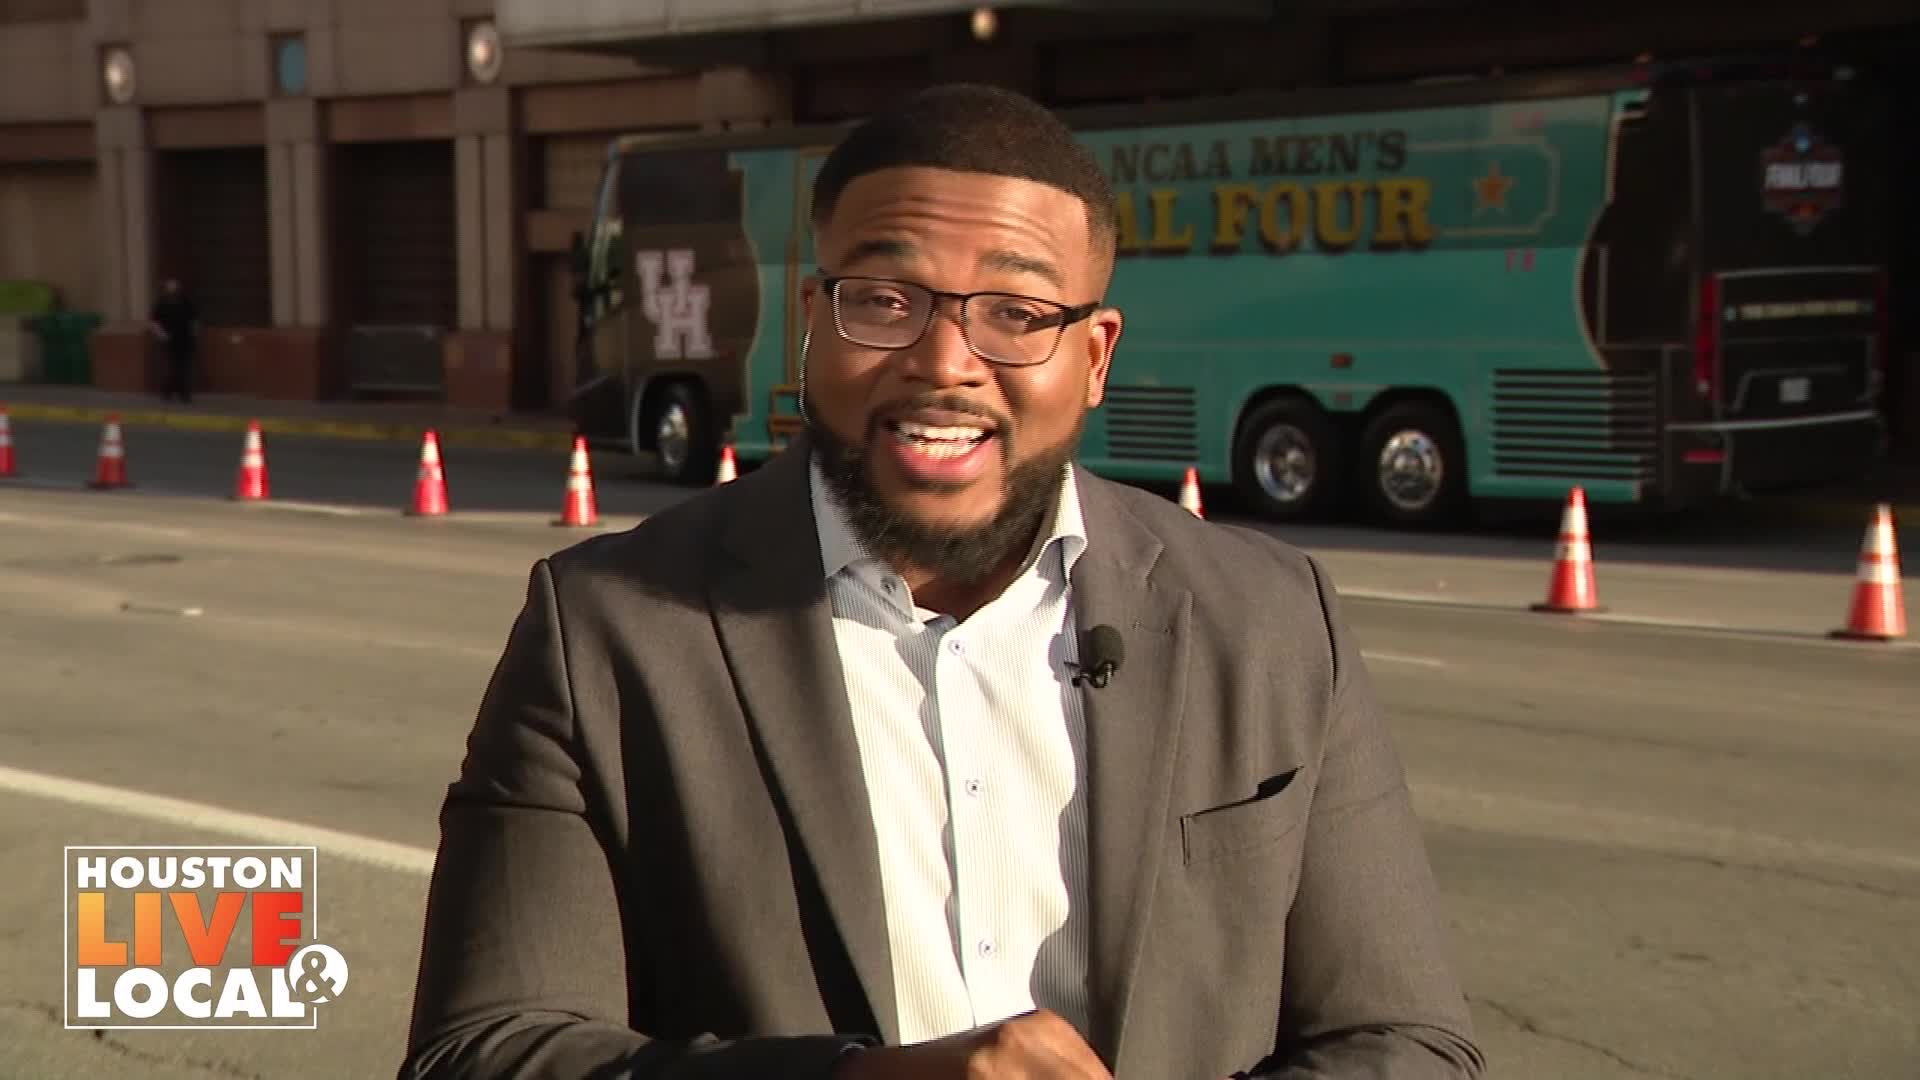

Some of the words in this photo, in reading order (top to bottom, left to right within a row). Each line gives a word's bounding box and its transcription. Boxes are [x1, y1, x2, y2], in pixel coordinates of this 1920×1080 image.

[1111, 139, 1233, 183] NCAA
[1250, 130, 1407, 177] MEN'S
[1211, 177, 1434, 255] FOUR
